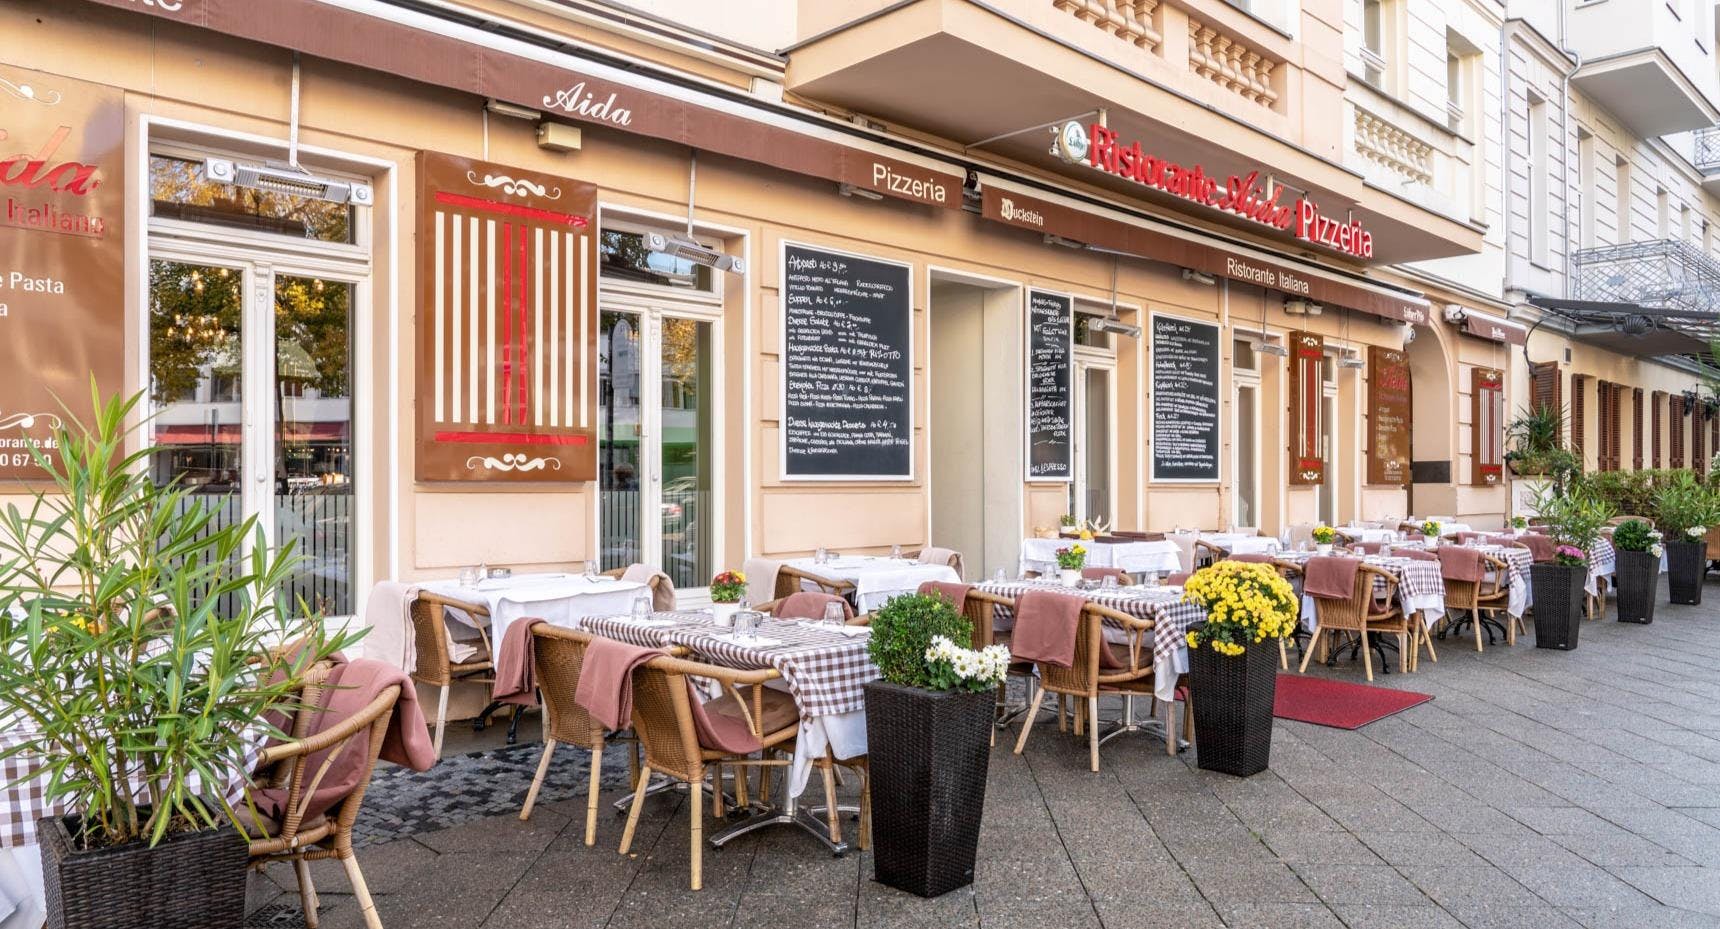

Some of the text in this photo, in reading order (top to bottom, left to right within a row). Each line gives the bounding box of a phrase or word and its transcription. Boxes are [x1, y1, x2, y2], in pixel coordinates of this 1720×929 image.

[543, 82, 632, 126] Aida
[873, 163, 946, 203] Pizzeria
[1090, 123, 1373, 259] Ristorante Aida Pizzeria
[10, 272, 65, 295] Pasta
[1227, 257, 1310, 294] Ristorante Italiana
[13, 454, 30, 467] 67
